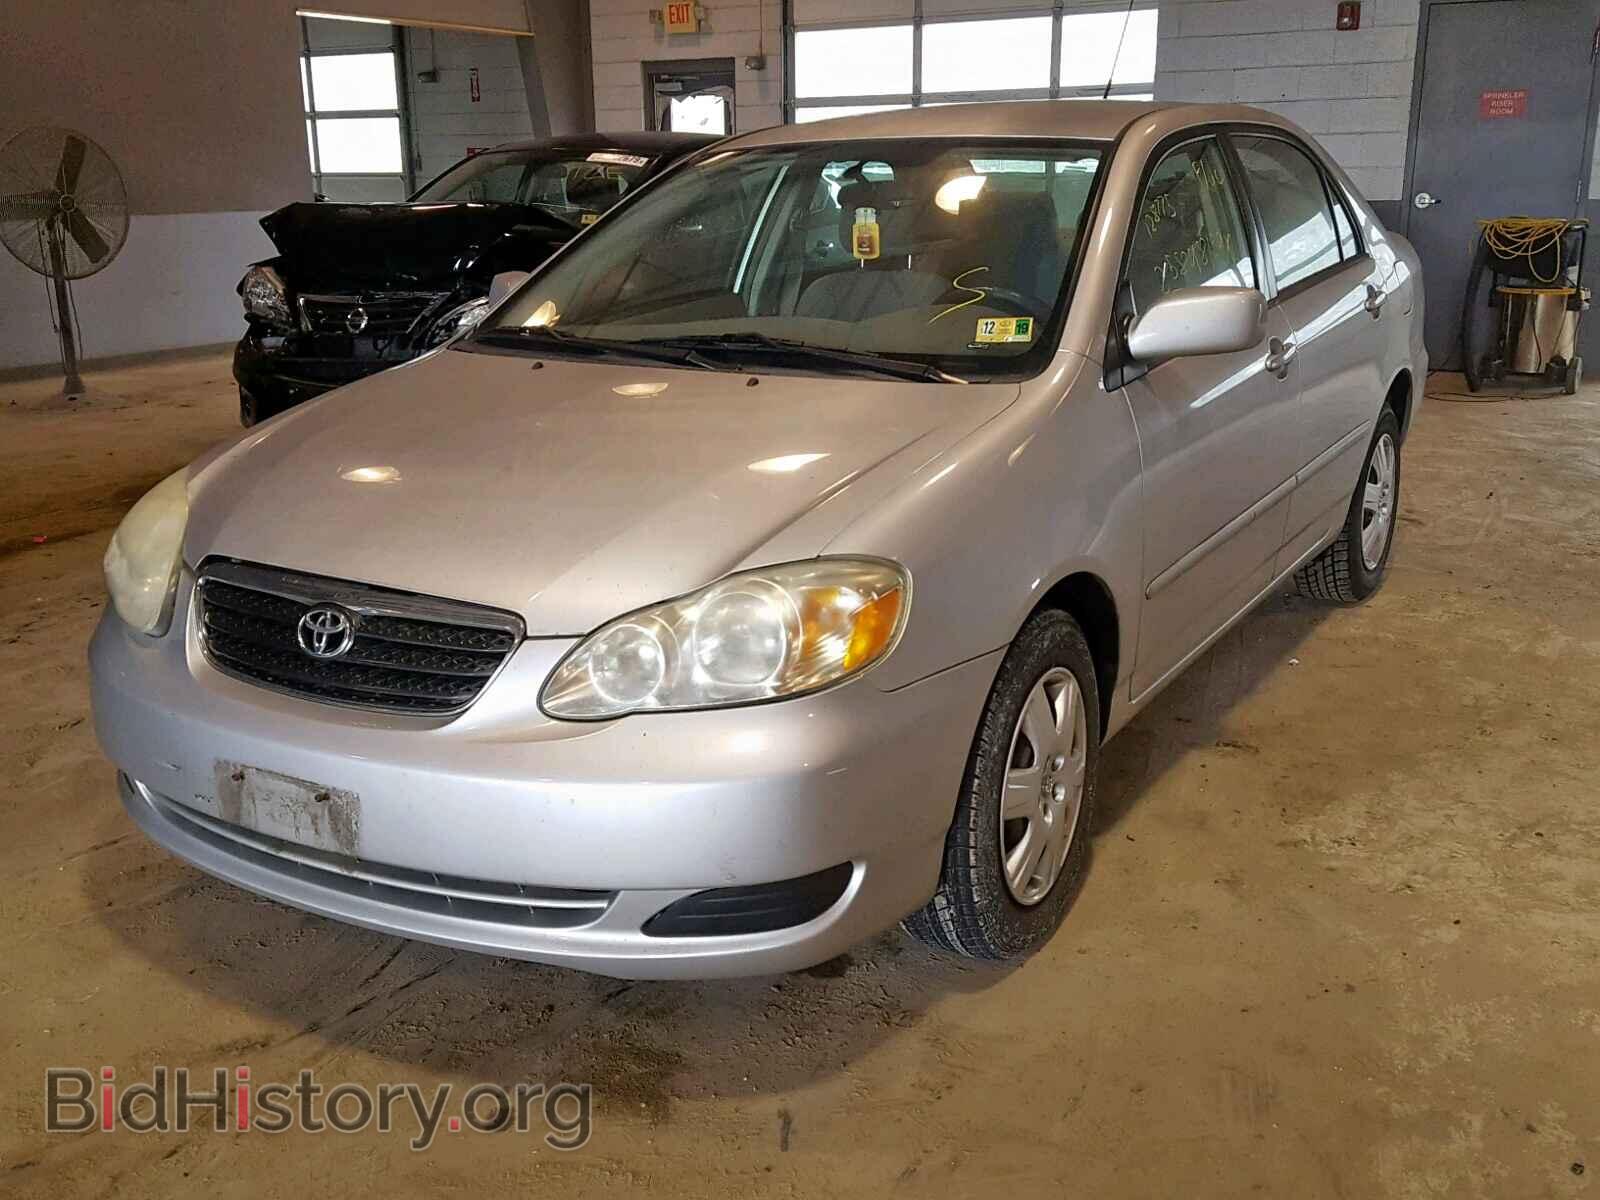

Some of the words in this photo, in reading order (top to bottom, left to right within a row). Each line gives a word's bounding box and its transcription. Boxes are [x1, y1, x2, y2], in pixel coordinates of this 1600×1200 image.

[669, 4, 689, 24] EXIT
[983, 321, 996, 335] 12
[1015, 321, 1028, 335] 19
